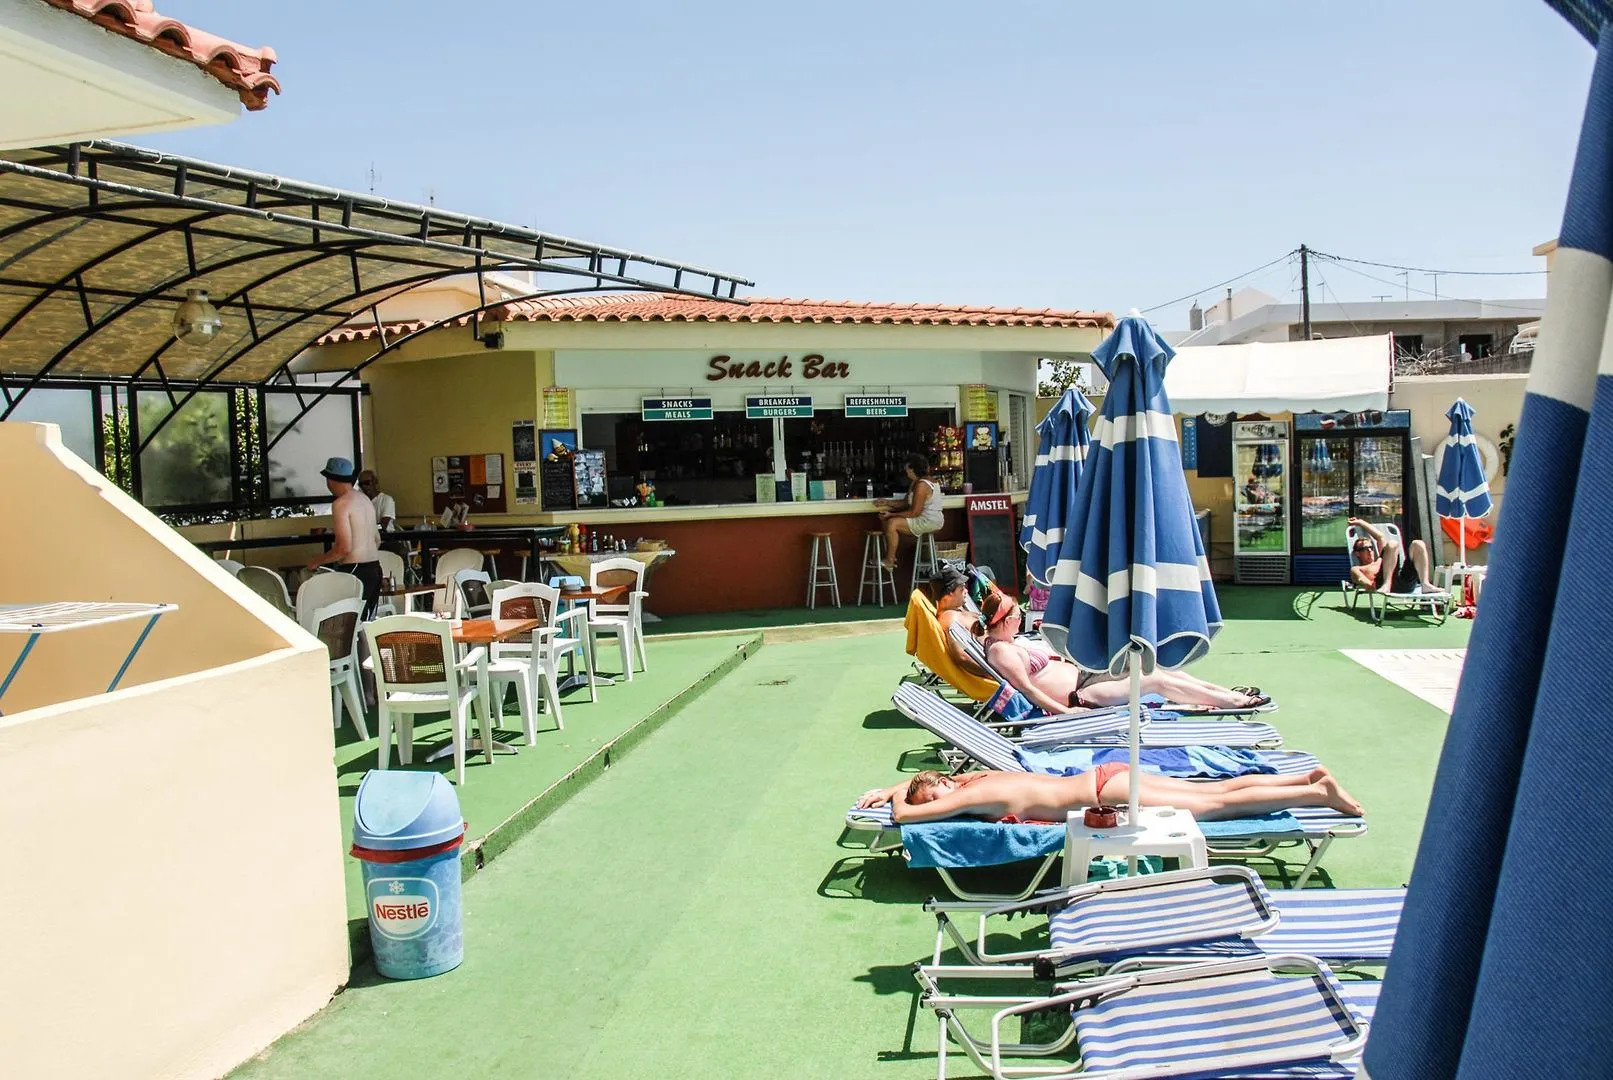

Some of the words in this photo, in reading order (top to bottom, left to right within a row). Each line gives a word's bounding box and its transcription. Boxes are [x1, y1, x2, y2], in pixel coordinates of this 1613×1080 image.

[706, 355, 792, 381] Snack
[801, 354, 850, 379] Bar
[661, 400, 693, 408] SNACKS
[758, 398, 799, 406] BREAKFAST
[664, 411, 691, 419] MEALS
[763, 408, 797, 416] BURGERS
[970, 500, 1009, 511] AMSTEL
